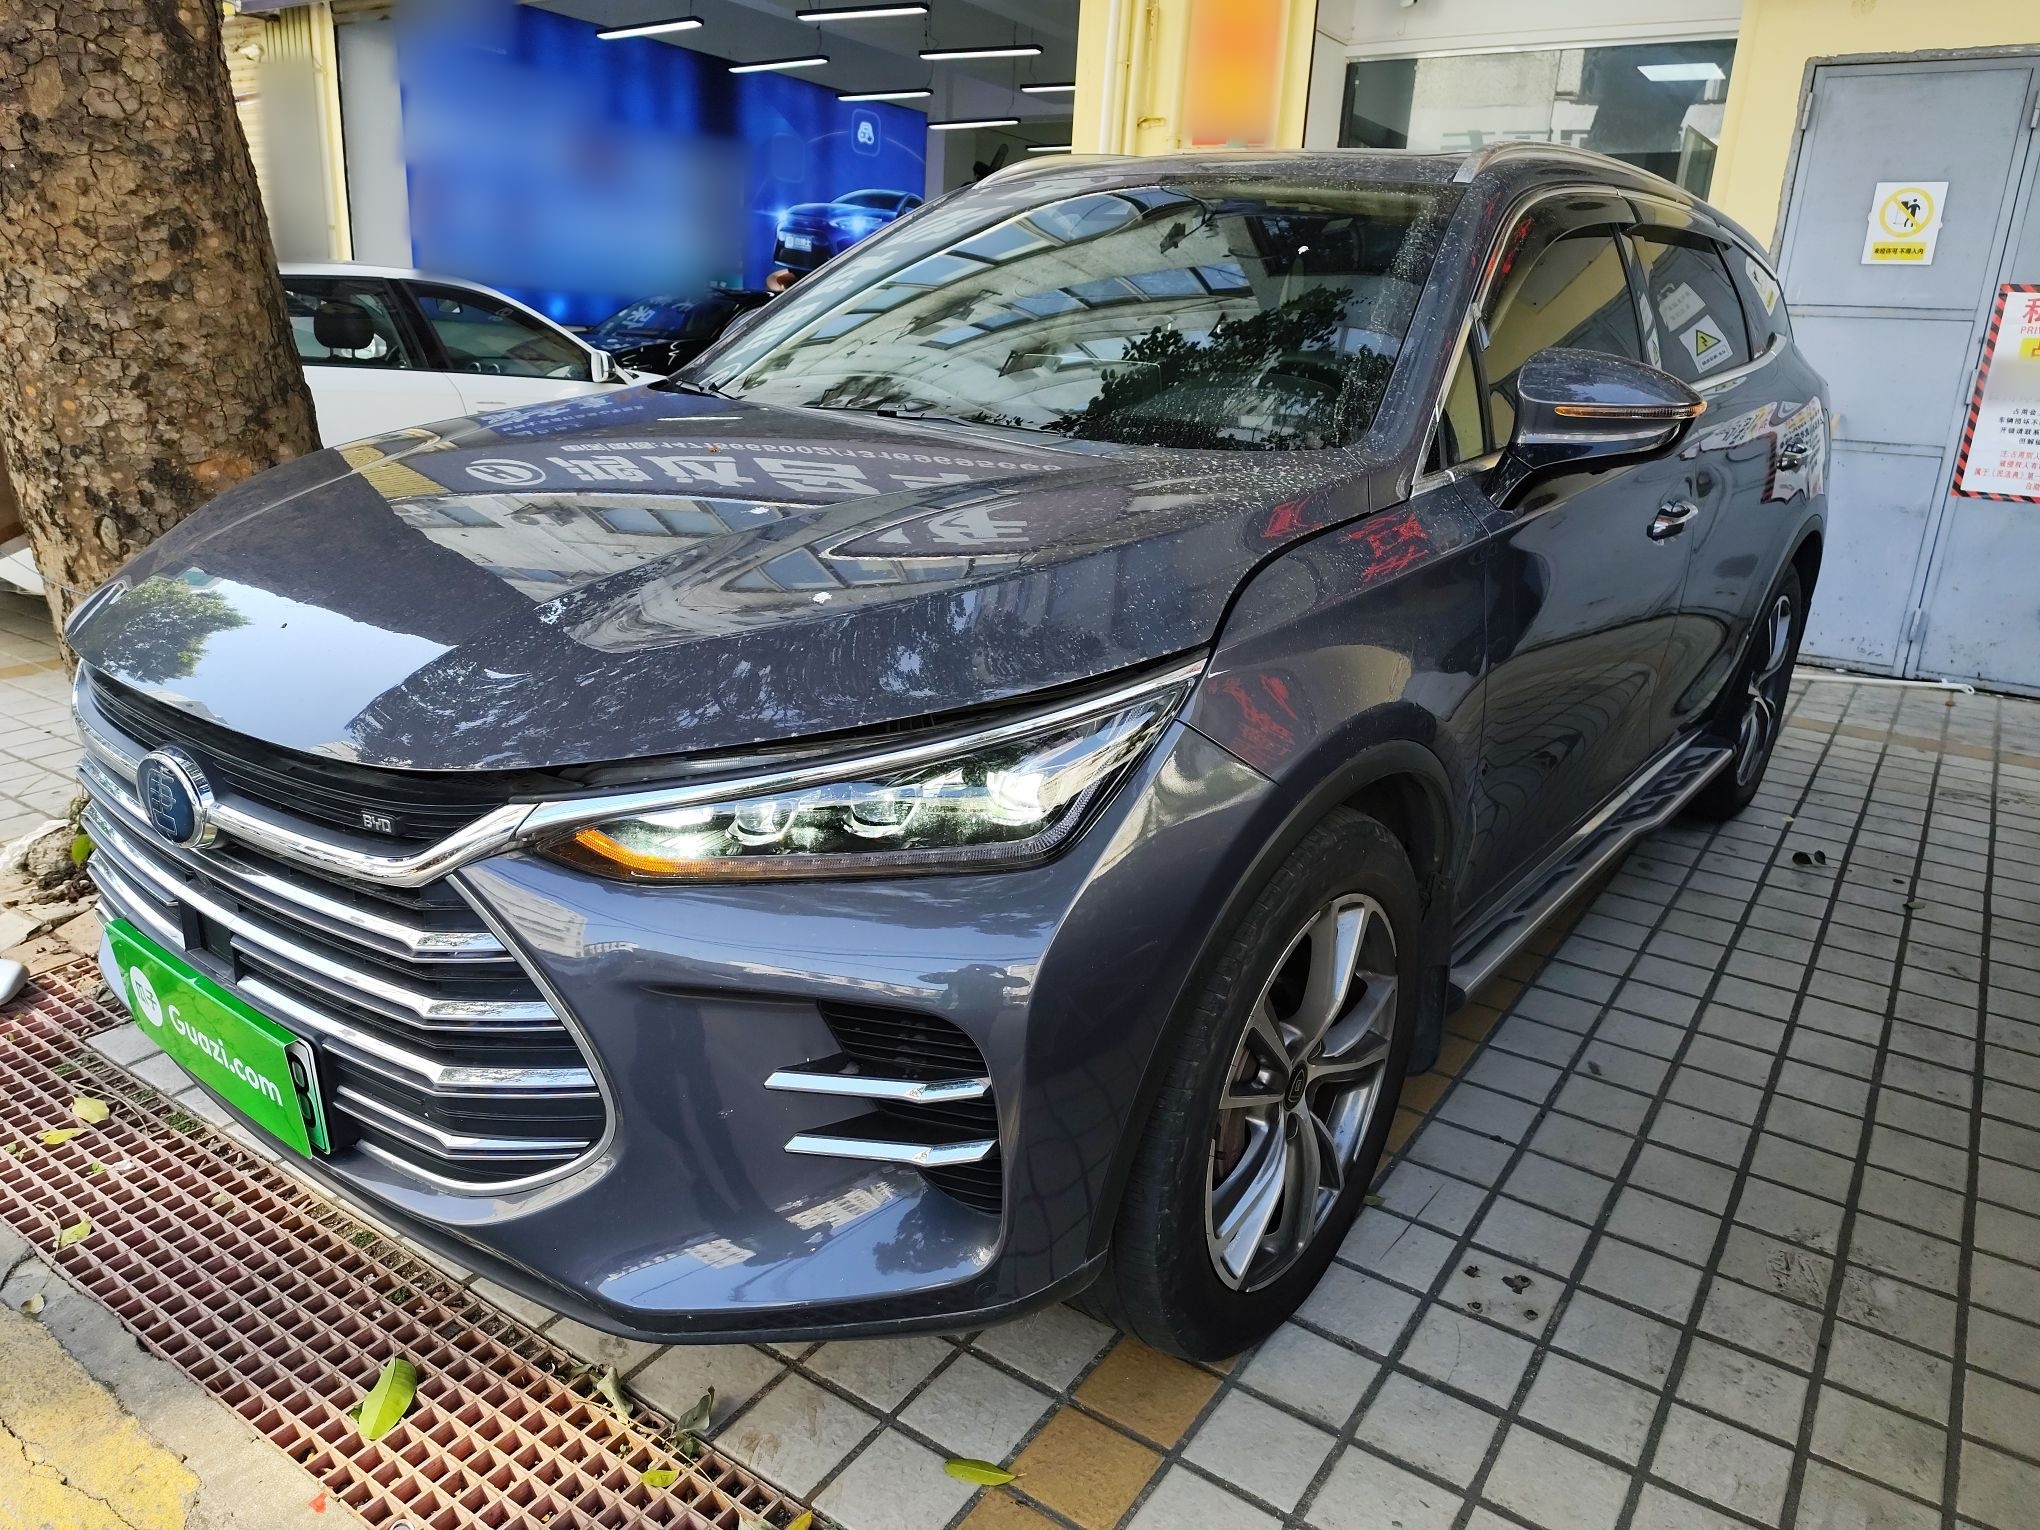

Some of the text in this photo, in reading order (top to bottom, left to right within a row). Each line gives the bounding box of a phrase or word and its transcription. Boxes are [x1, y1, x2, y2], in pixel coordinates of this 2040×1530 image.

[362, 814, 392, 833] BYD
[134, 980, 158, 1012] 瓜子
[168, 1004, 284, 1107] Guazi.com
